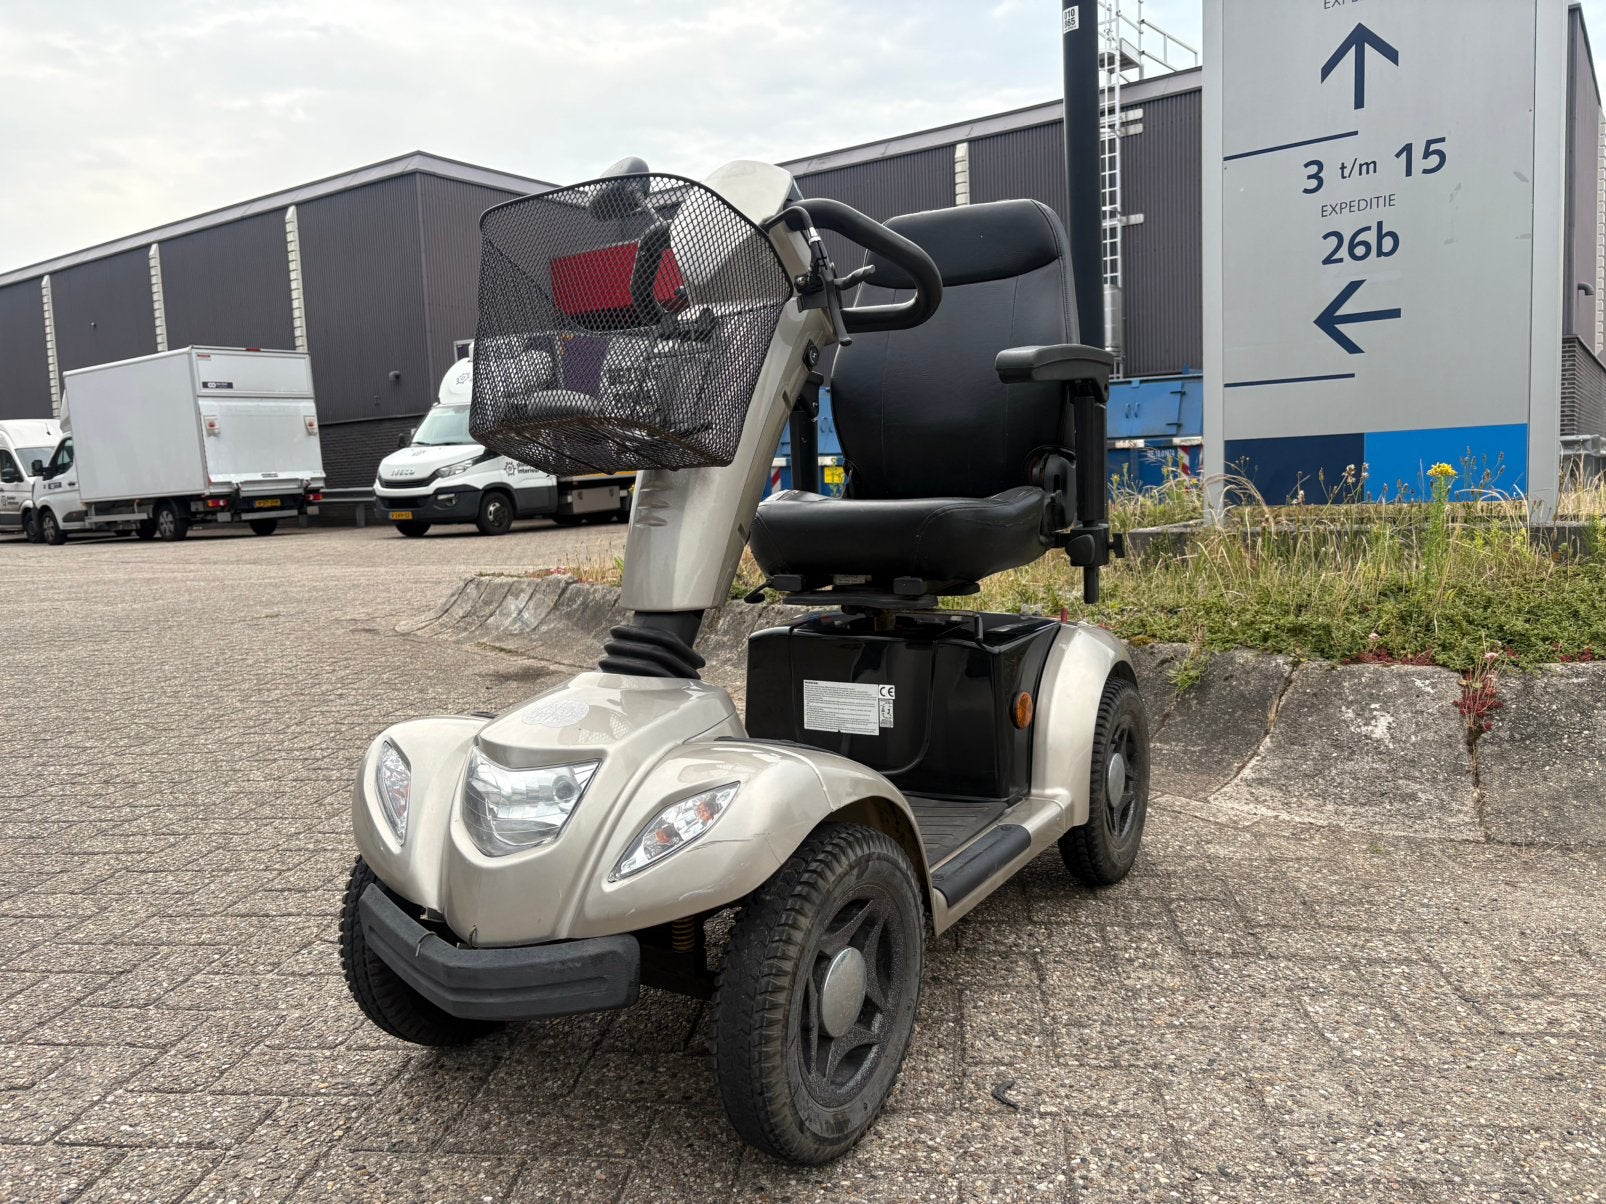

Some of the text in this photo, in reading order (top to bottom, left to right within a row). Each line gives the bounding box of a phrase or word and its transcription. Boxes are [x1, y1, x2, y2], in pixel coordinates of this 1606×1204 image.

[1302, 137, 1447, 194] 3 t/m 15
[1321, 194, 1396, 218] EXPEDITIE
[1321, 220, 1400, 266] 26b
[391, 467, 415, 476] IVECO
[880, 686, 894, 697] CE
